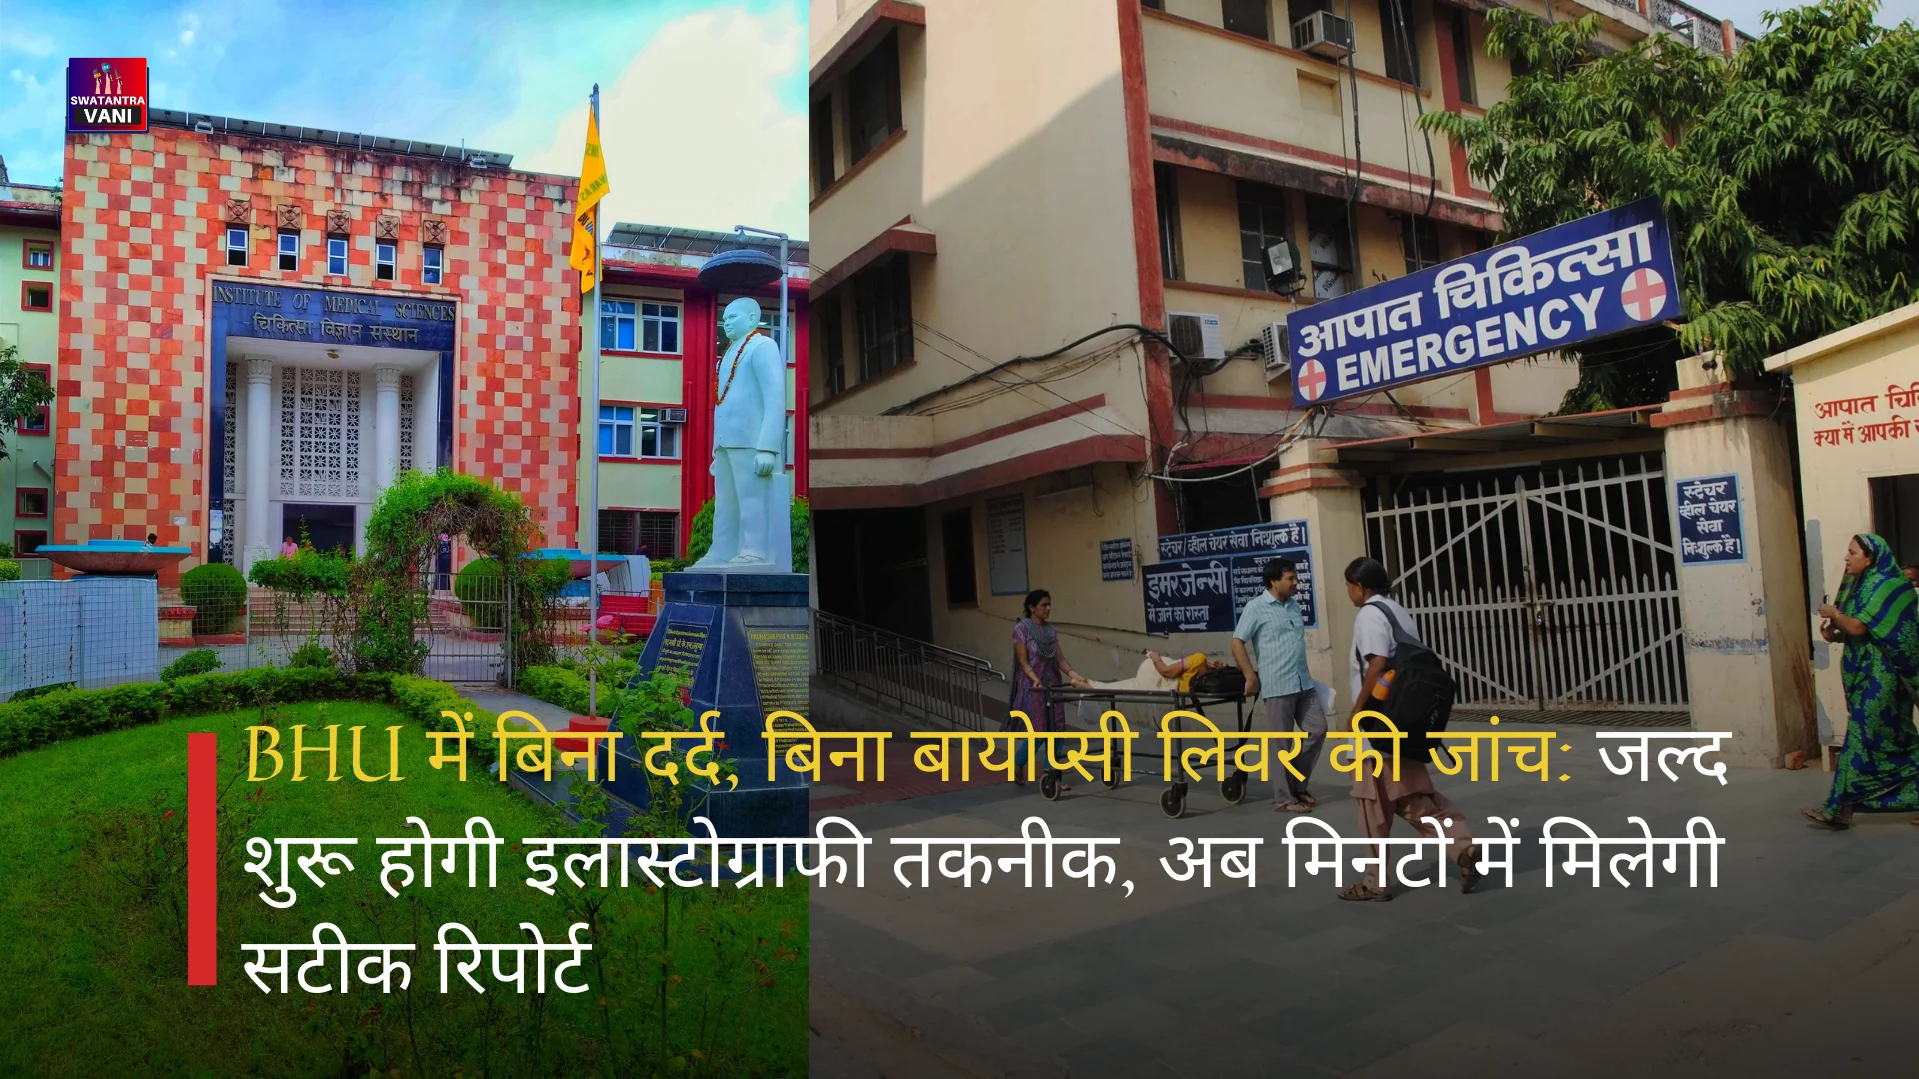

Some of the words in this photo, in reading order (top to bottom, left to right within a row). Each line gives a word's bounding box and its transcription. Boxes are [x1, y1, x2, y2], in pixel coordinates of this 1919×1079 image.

[213, 285, 281, 309] INSTITUTE
[293, 293, 311, 310] OF
[324, 295, 381, 317] MEDICAL
[395, 302, 455, 322] SCIENCES
[1298, 292, 1422, 358] आपात
[1434, 221, 1654, 320] चिकित्सा
[252, 311, 313, 336] चिकित्सा
[320, 317, 362, 340] विज्ञान
[370, 323, 419, 343] संस्थान
[1336, 286, 1605, 392] EMERGENCY
[1814, 395, 1879, 419] आपात
[1814, 428, 1841, 447] क्या
[1858, 414, 1911, 443] आपकी
[1682, 480, 1728, 500] स्ट्रेचर
[1679, 500, 1707, 520] व्हील
[1708, 497, 1737, 514] चेयर
[1696, 517, 1724, 535] सेवा
[1208, 533, 1229, 551] चेयर
[1229, 530, 1249, 550] सेवा
[1146, 560, 1228, 603] इमरजेन्सी
[1156, 601, 1173, 623] जाने
[1173, 606, 1186, 621] का
[1186, 605, 1210, 622] रास्ता
